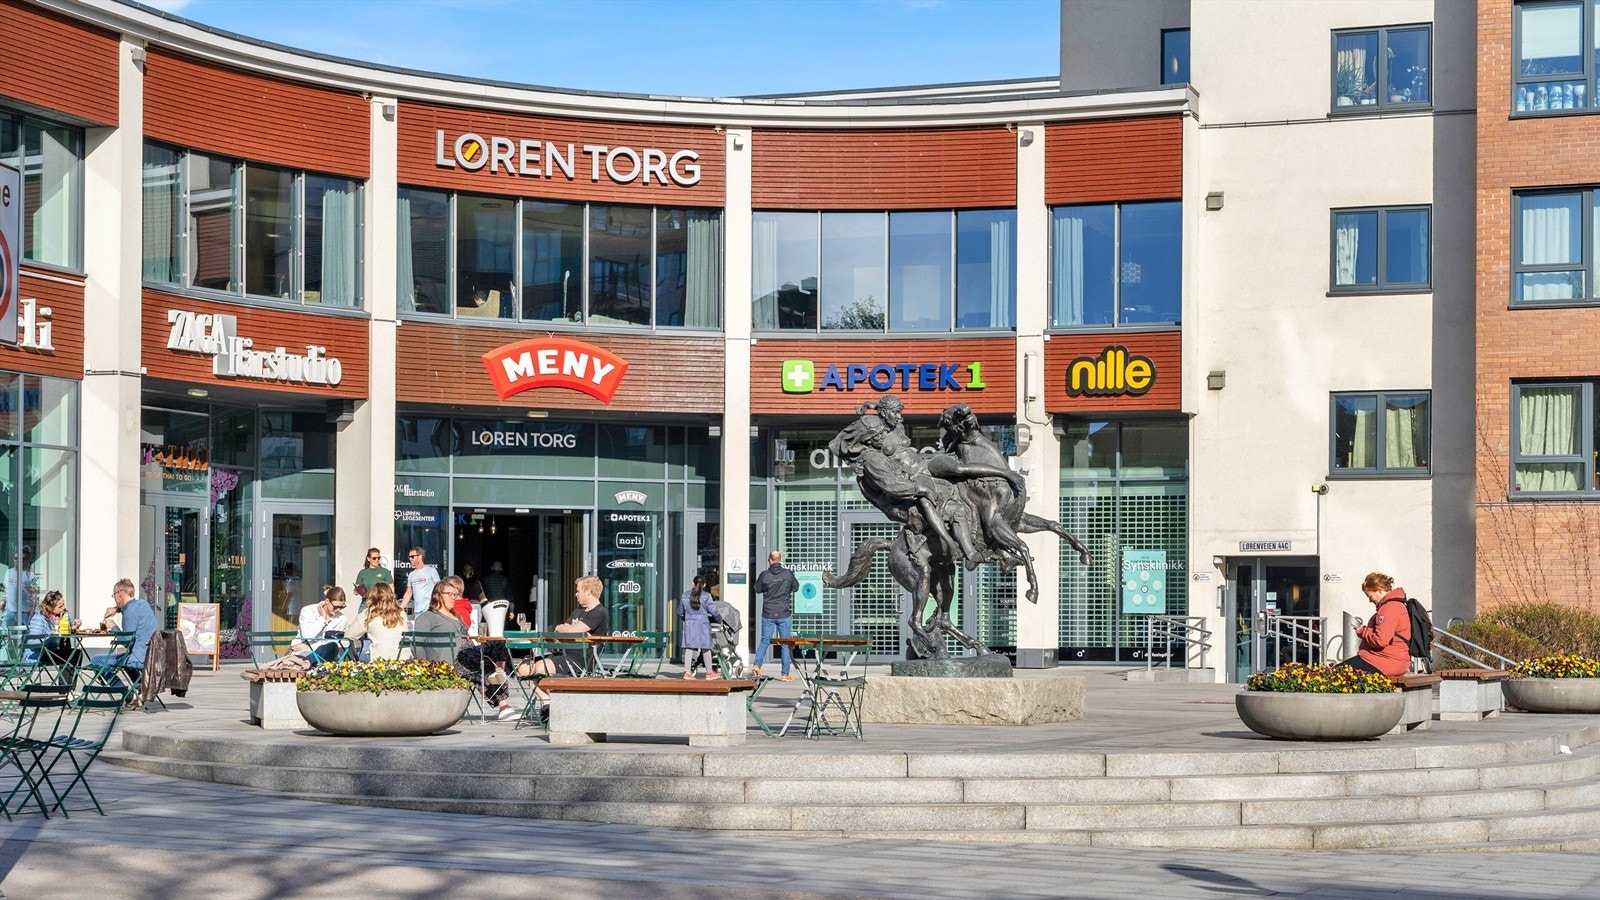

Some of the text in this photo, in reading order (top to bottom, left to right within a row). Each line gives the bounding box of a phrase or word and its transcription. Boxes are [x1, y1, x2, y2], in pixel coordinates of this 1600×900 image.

[435, 129, 702, 186] LØREN TORG
[167, 309, 229, 356] ZAGA
[501, 349, 616, 385] MENY
[1071, 349, 1152, 390] nille
[472, 430, 577, 449] LØREN TORG
[618, 493, 645, 502] MENY
[619, 536, 642, 545] norli
[1242, 541, 1289, 550] LØRENVEIEN 44C
[1123, 559, 1184, 573] Synsklinikk
[619, 581, 641, 593] nille
